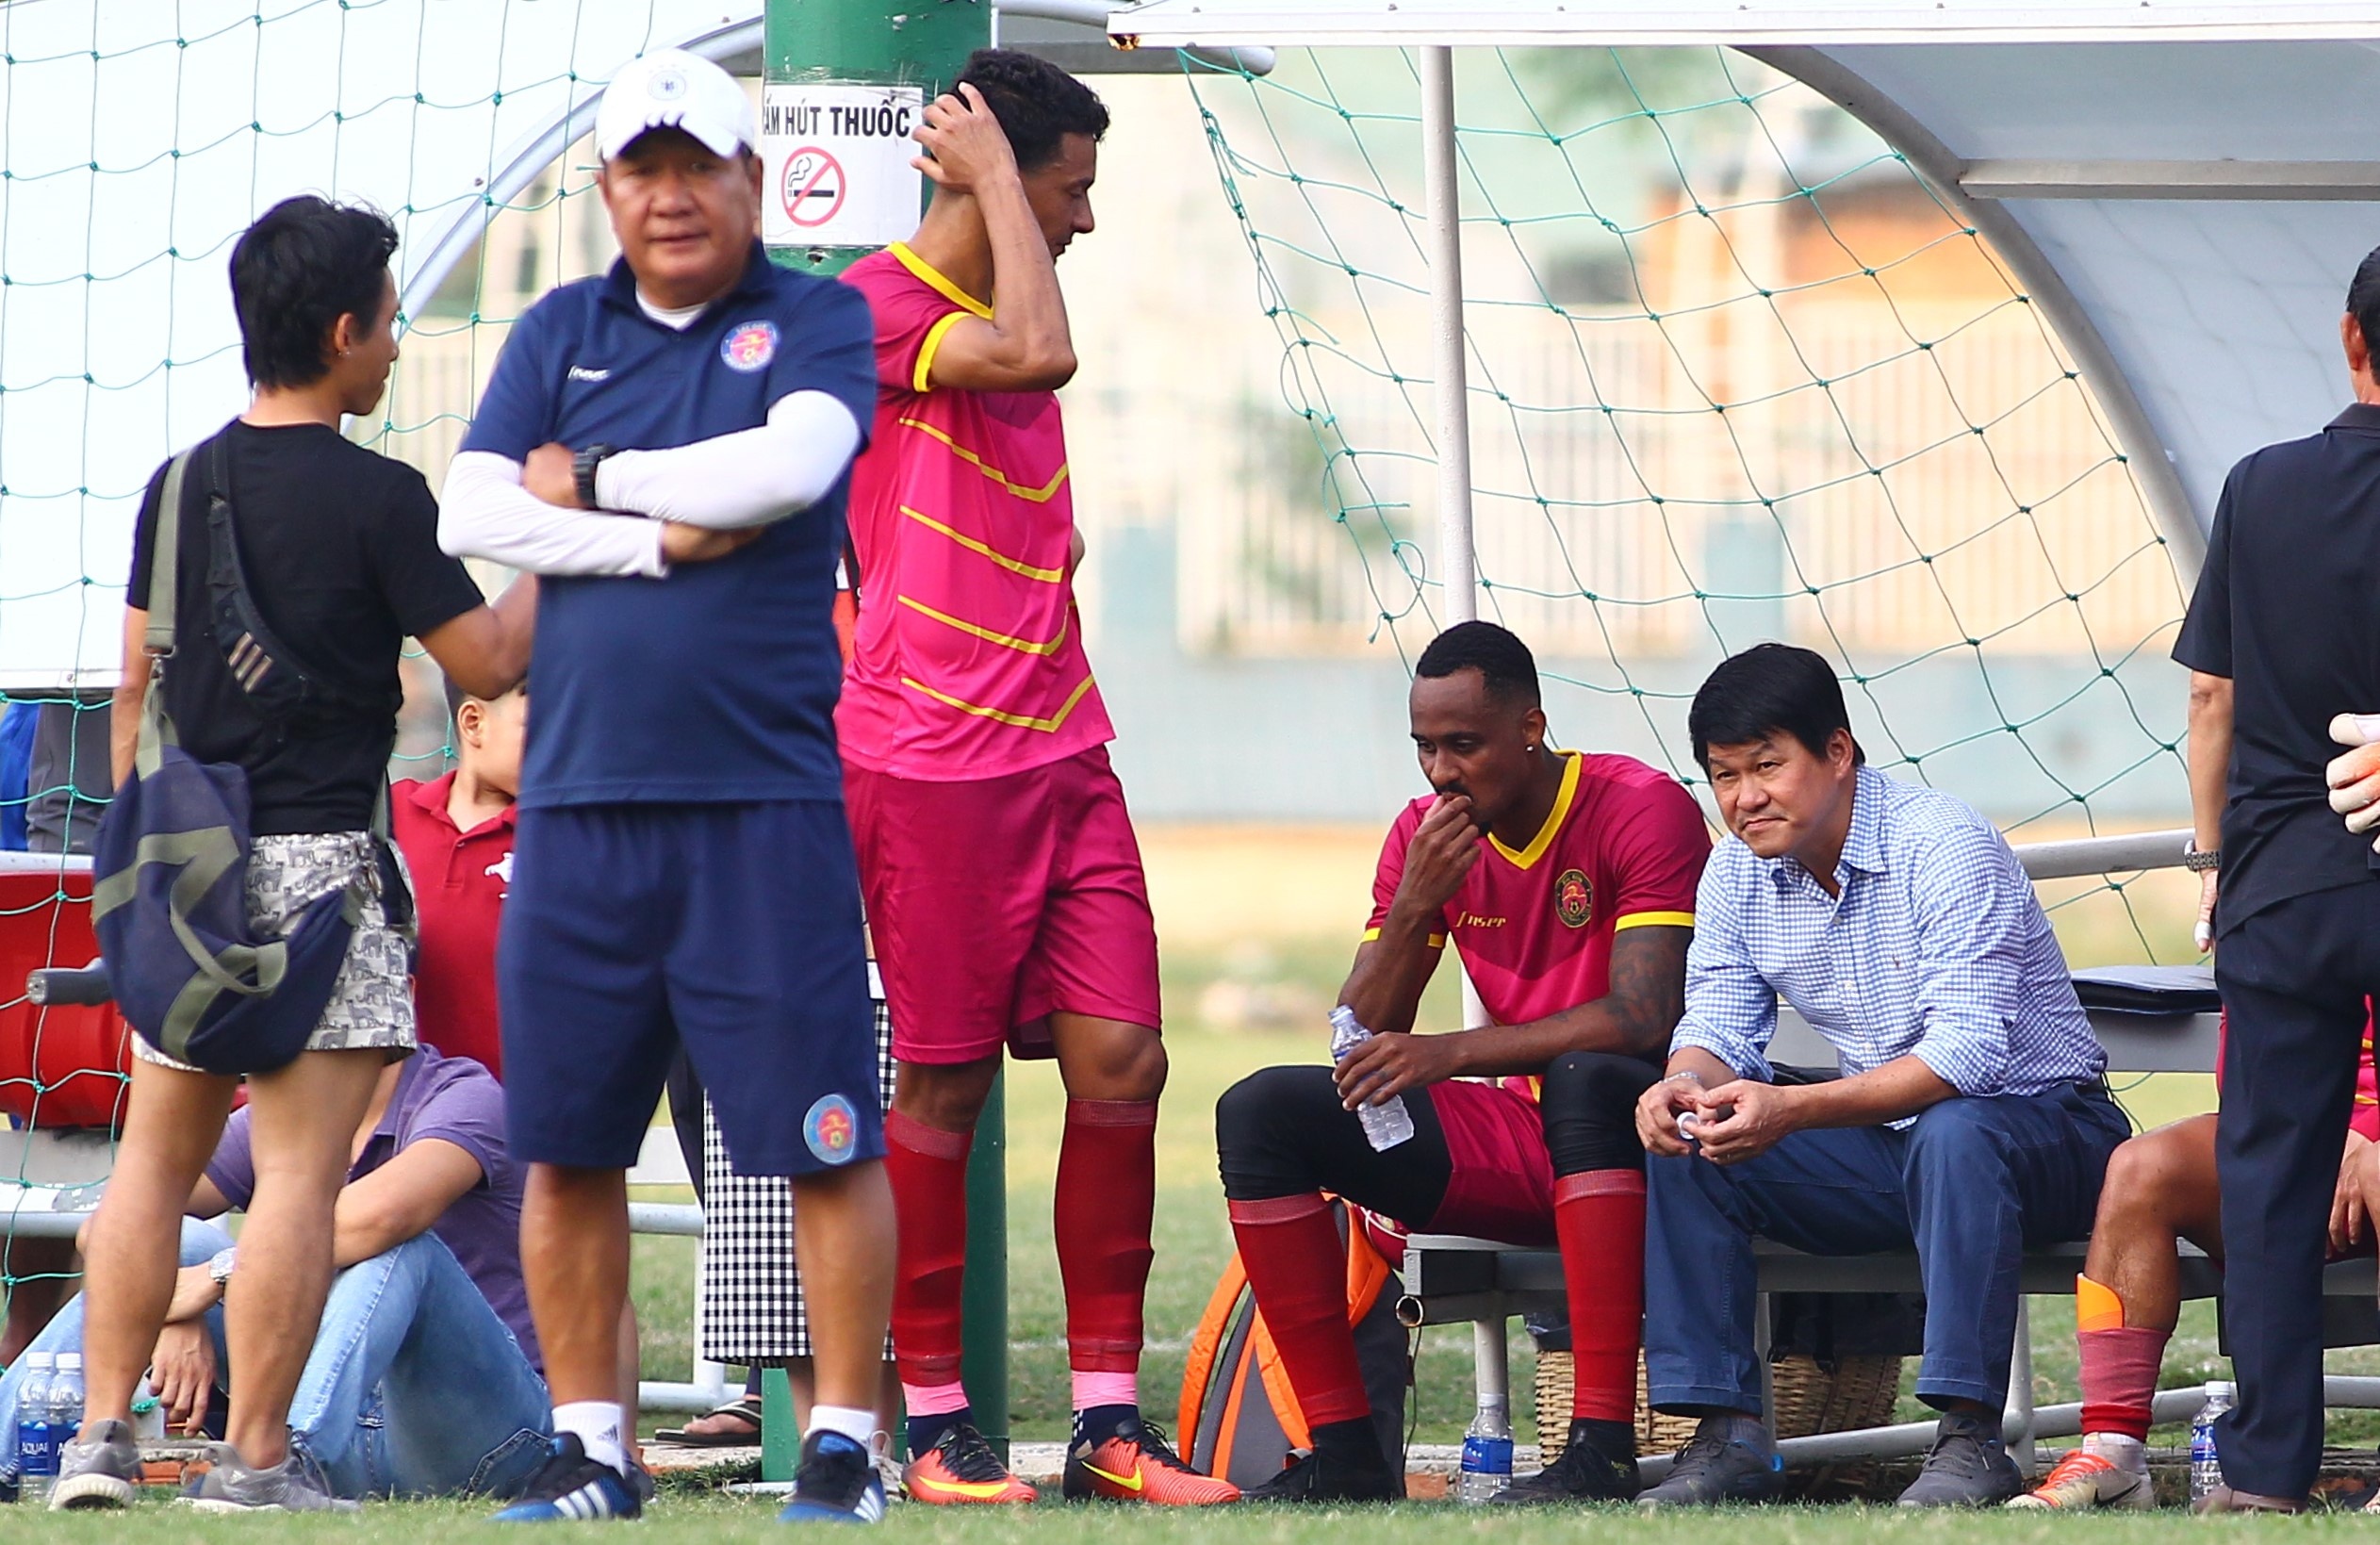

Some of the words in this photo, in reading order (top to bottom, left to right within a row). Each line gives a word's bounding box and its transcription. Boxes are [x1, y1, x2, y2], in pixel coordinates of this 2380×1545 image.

[763, 93, 780, 135] ẤM
[785, 97, 821, 135] HÚT
[829, 95, 910, 137] THUỐC
